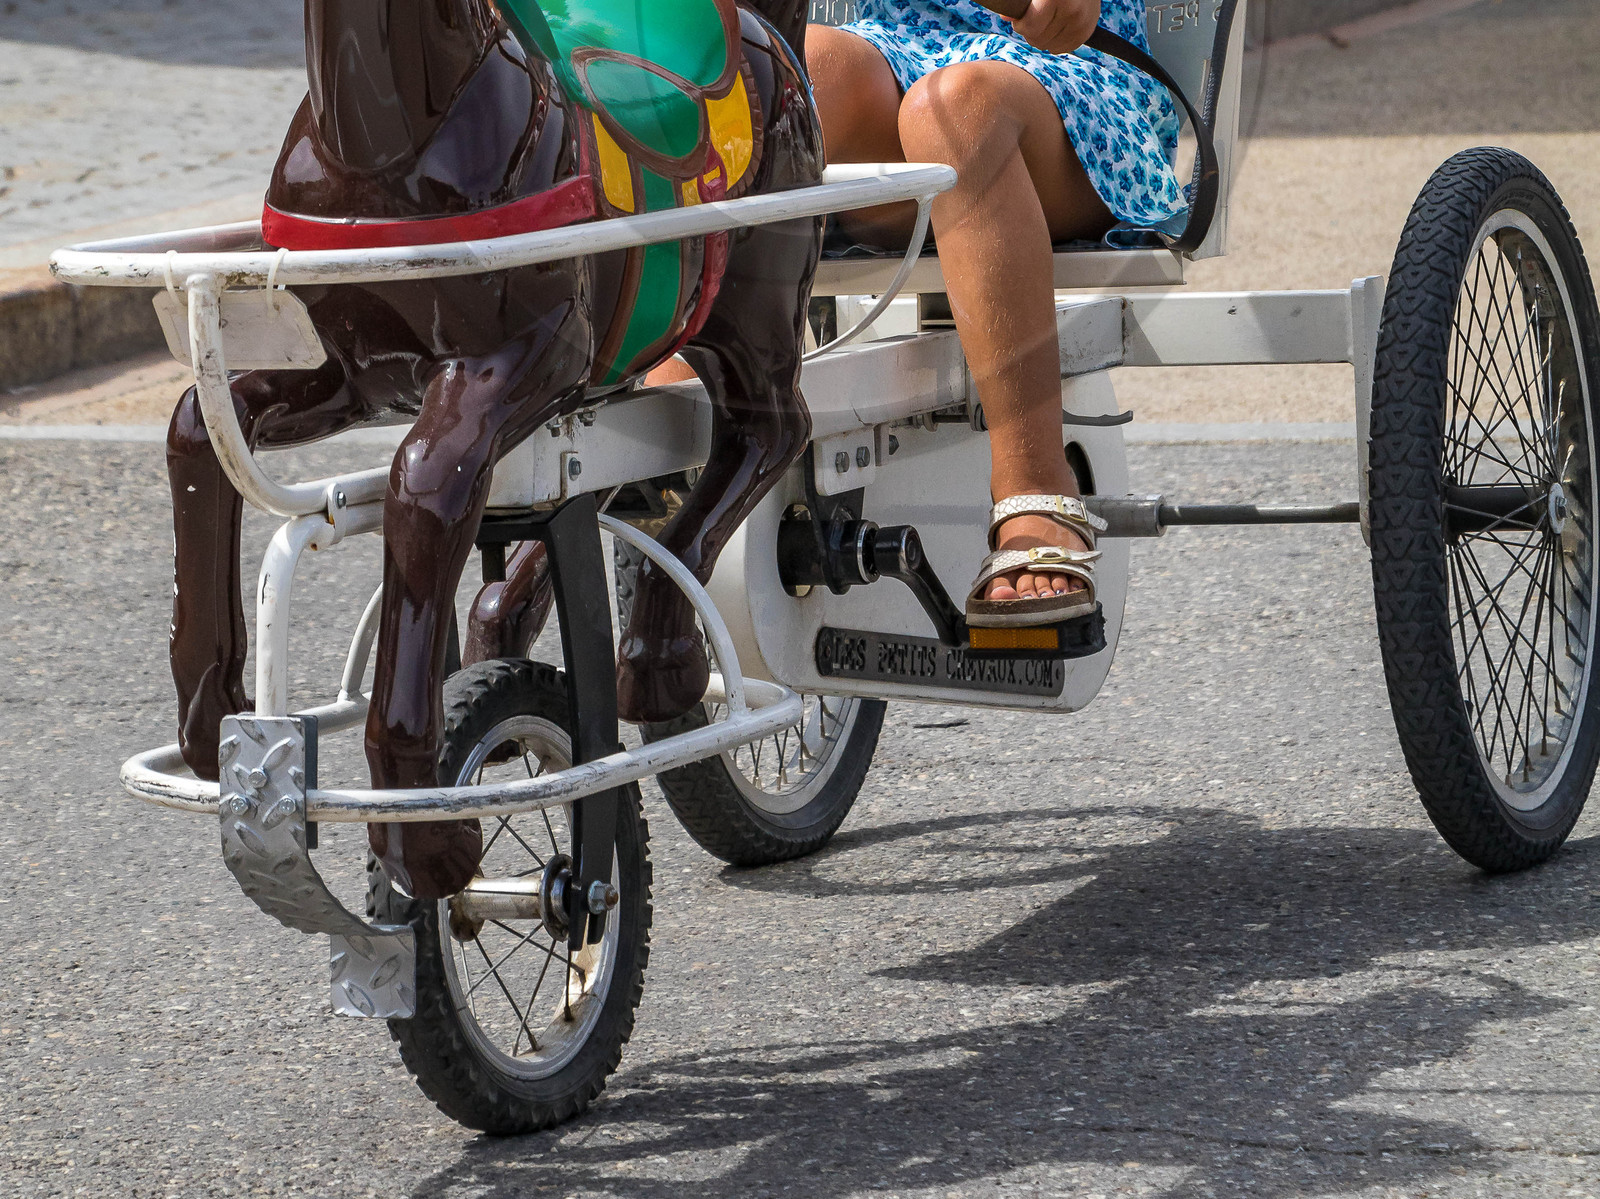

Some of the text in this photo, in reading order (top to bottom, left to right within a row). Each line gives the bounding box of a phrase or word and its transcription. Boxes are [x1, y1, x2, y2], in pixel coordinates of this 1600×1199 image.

[832, 636, 1054, 688] LES PETITS CHEVAUX.COM
